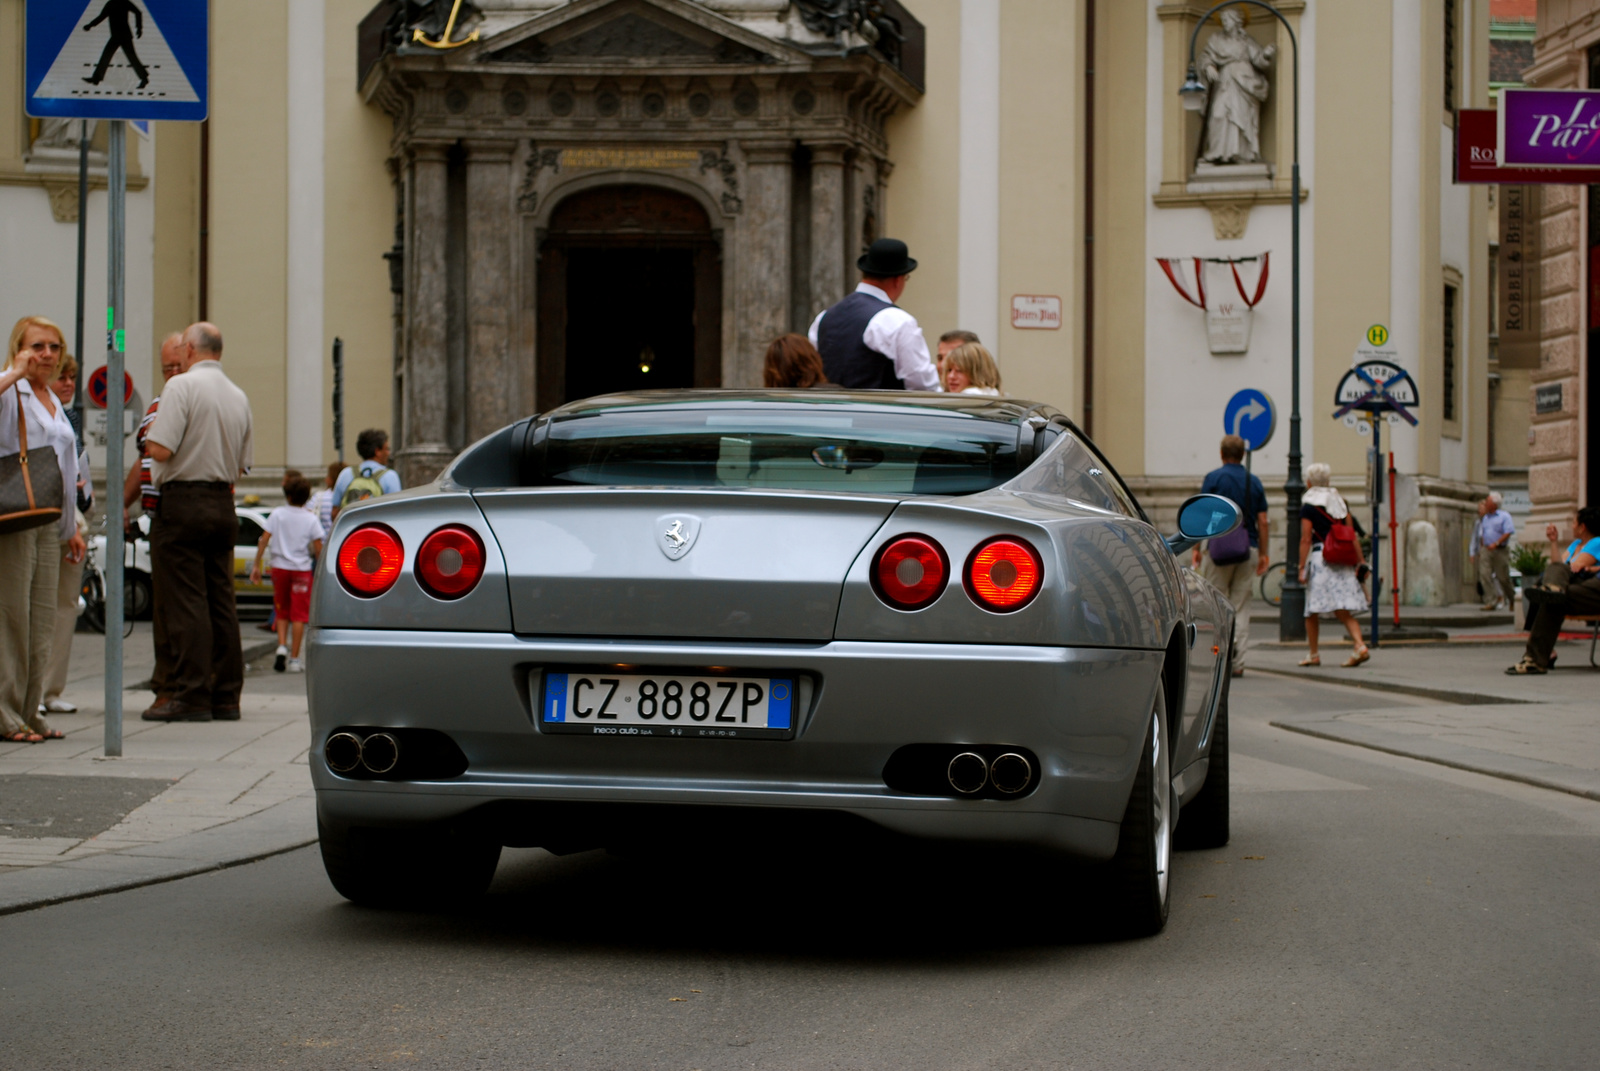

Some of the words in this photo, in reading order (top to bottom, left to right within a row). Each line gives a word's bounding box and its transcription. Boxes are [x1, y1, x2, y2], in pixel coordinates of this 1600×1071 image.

[1372, 329, 1384, 342] H
[572, 678, 620, 720] CZ
[637, 679, 764, 723] 888ZP
[593, 726, 617, 734] ineco
[619, 727, 639, 735] auto
